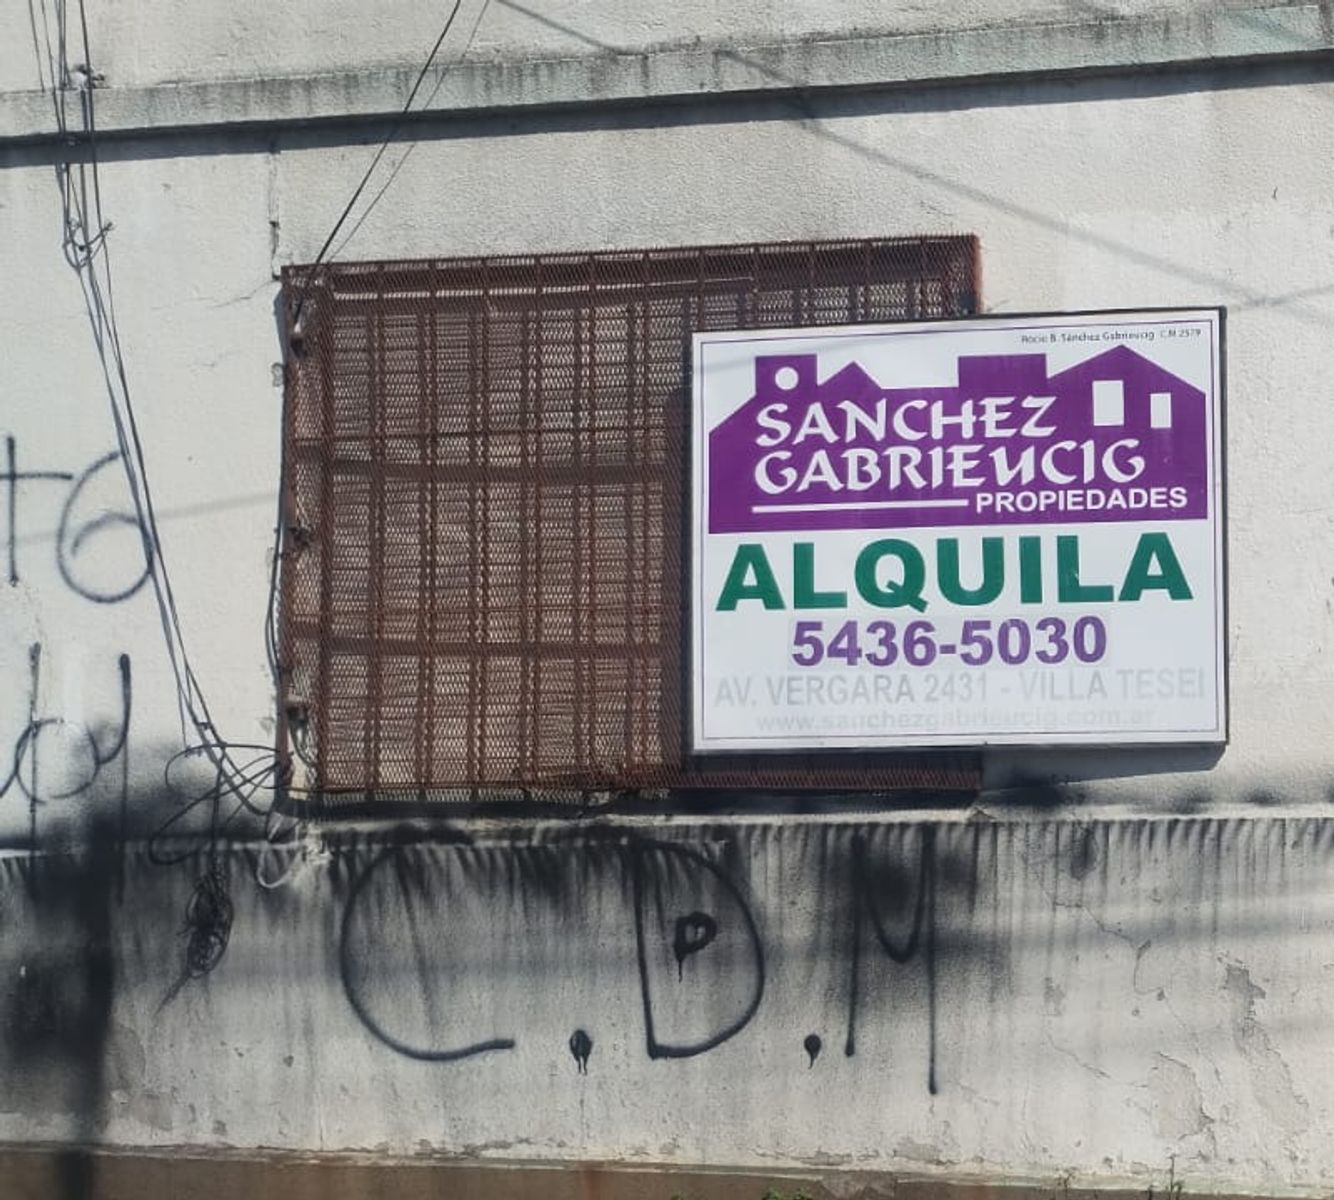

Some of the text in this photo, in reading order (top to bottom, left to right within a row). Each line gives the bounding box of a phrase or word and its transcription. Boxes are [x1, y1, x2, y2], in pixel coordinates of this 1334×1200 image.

[755, 395, 1058, 447] SANCHEZ
[753, 438, 1146, 494] GABRIEUCIG
[976, 487, 1189, 514] PROPIEDADES
[715, 532, 1195, 613] ALQUILA
[791, 614, 1108, 667] 5436-5030
[714, 676, 759, 708] AV.
[764, 672, 917, 706] VERGARA
[923, 671, 989, 702] 2431
[1018, 667, 1109, 701] VILLA
[1116, 666, 1205, 699] TESEI
